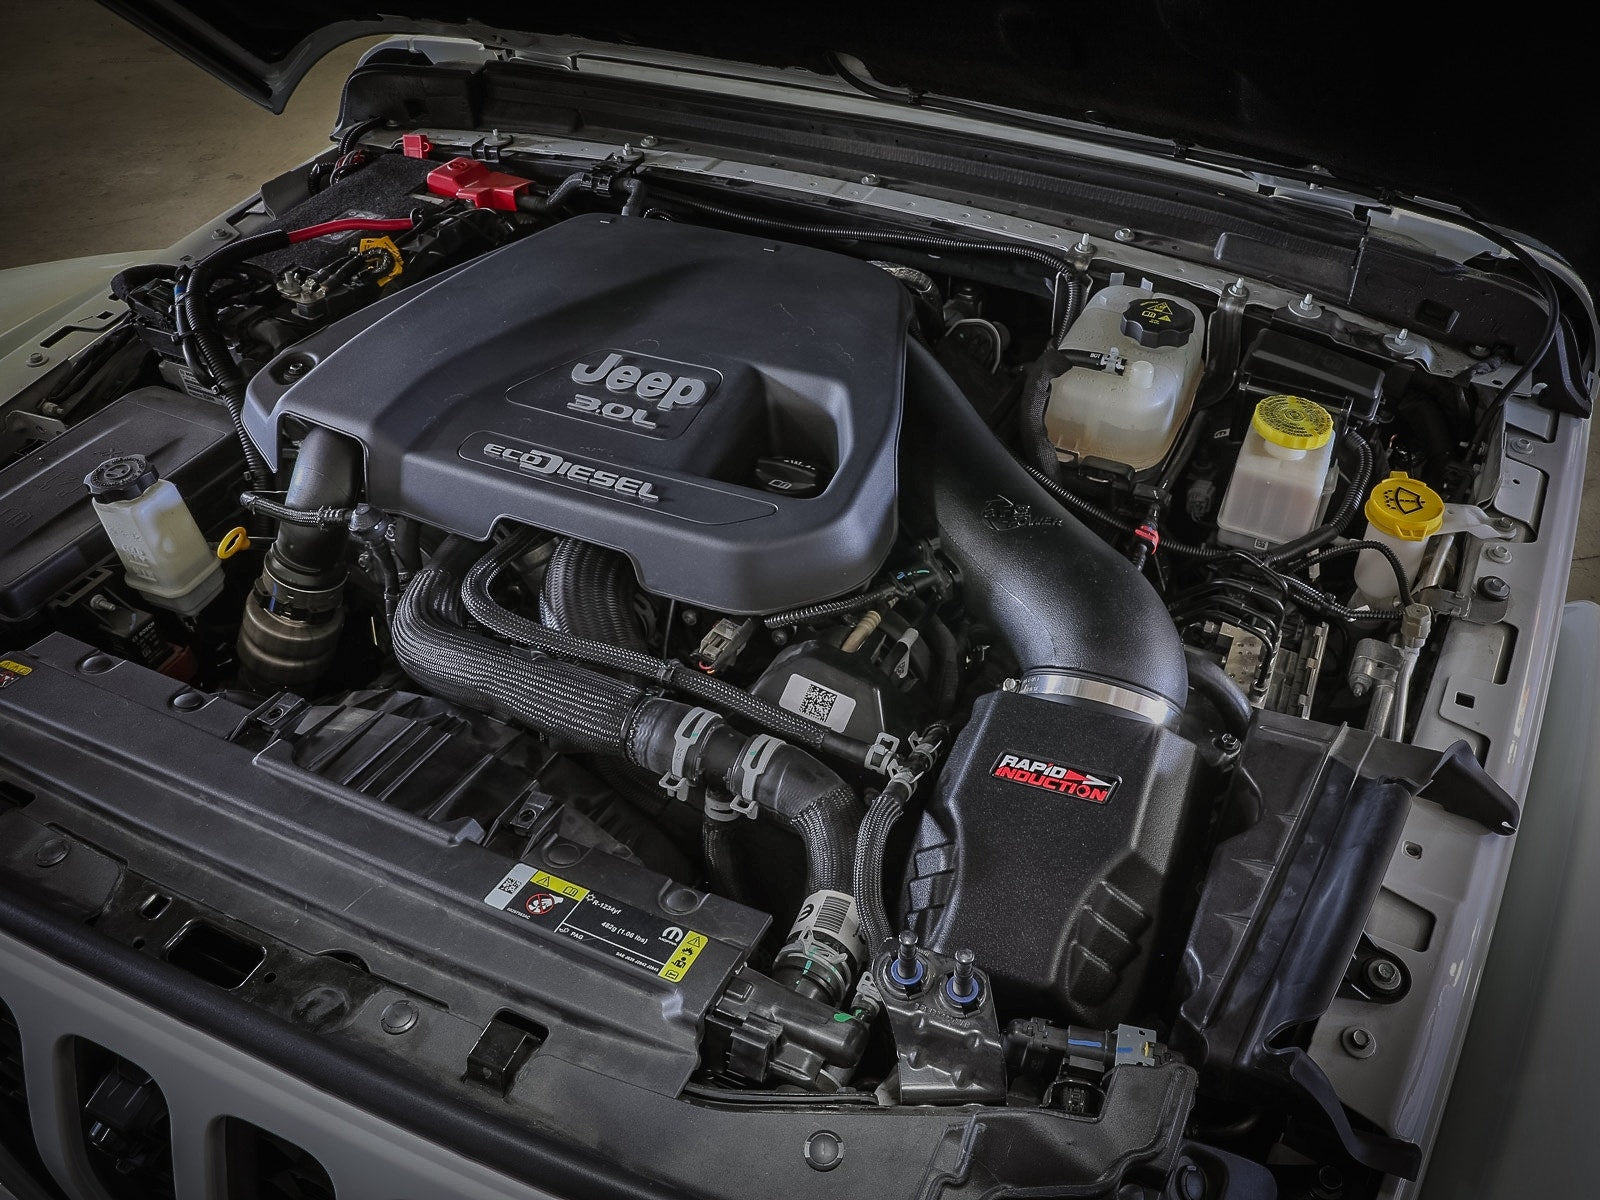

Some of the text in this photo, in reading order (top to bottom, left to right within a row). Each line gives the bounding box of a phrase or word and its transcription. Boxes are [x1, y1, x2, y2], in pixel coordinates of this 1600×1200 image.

[571, 352, 707, 411] Jeep
[566, 393, 657, 429] 3.0L
[593, 899, 622, 915] R-1234yf
